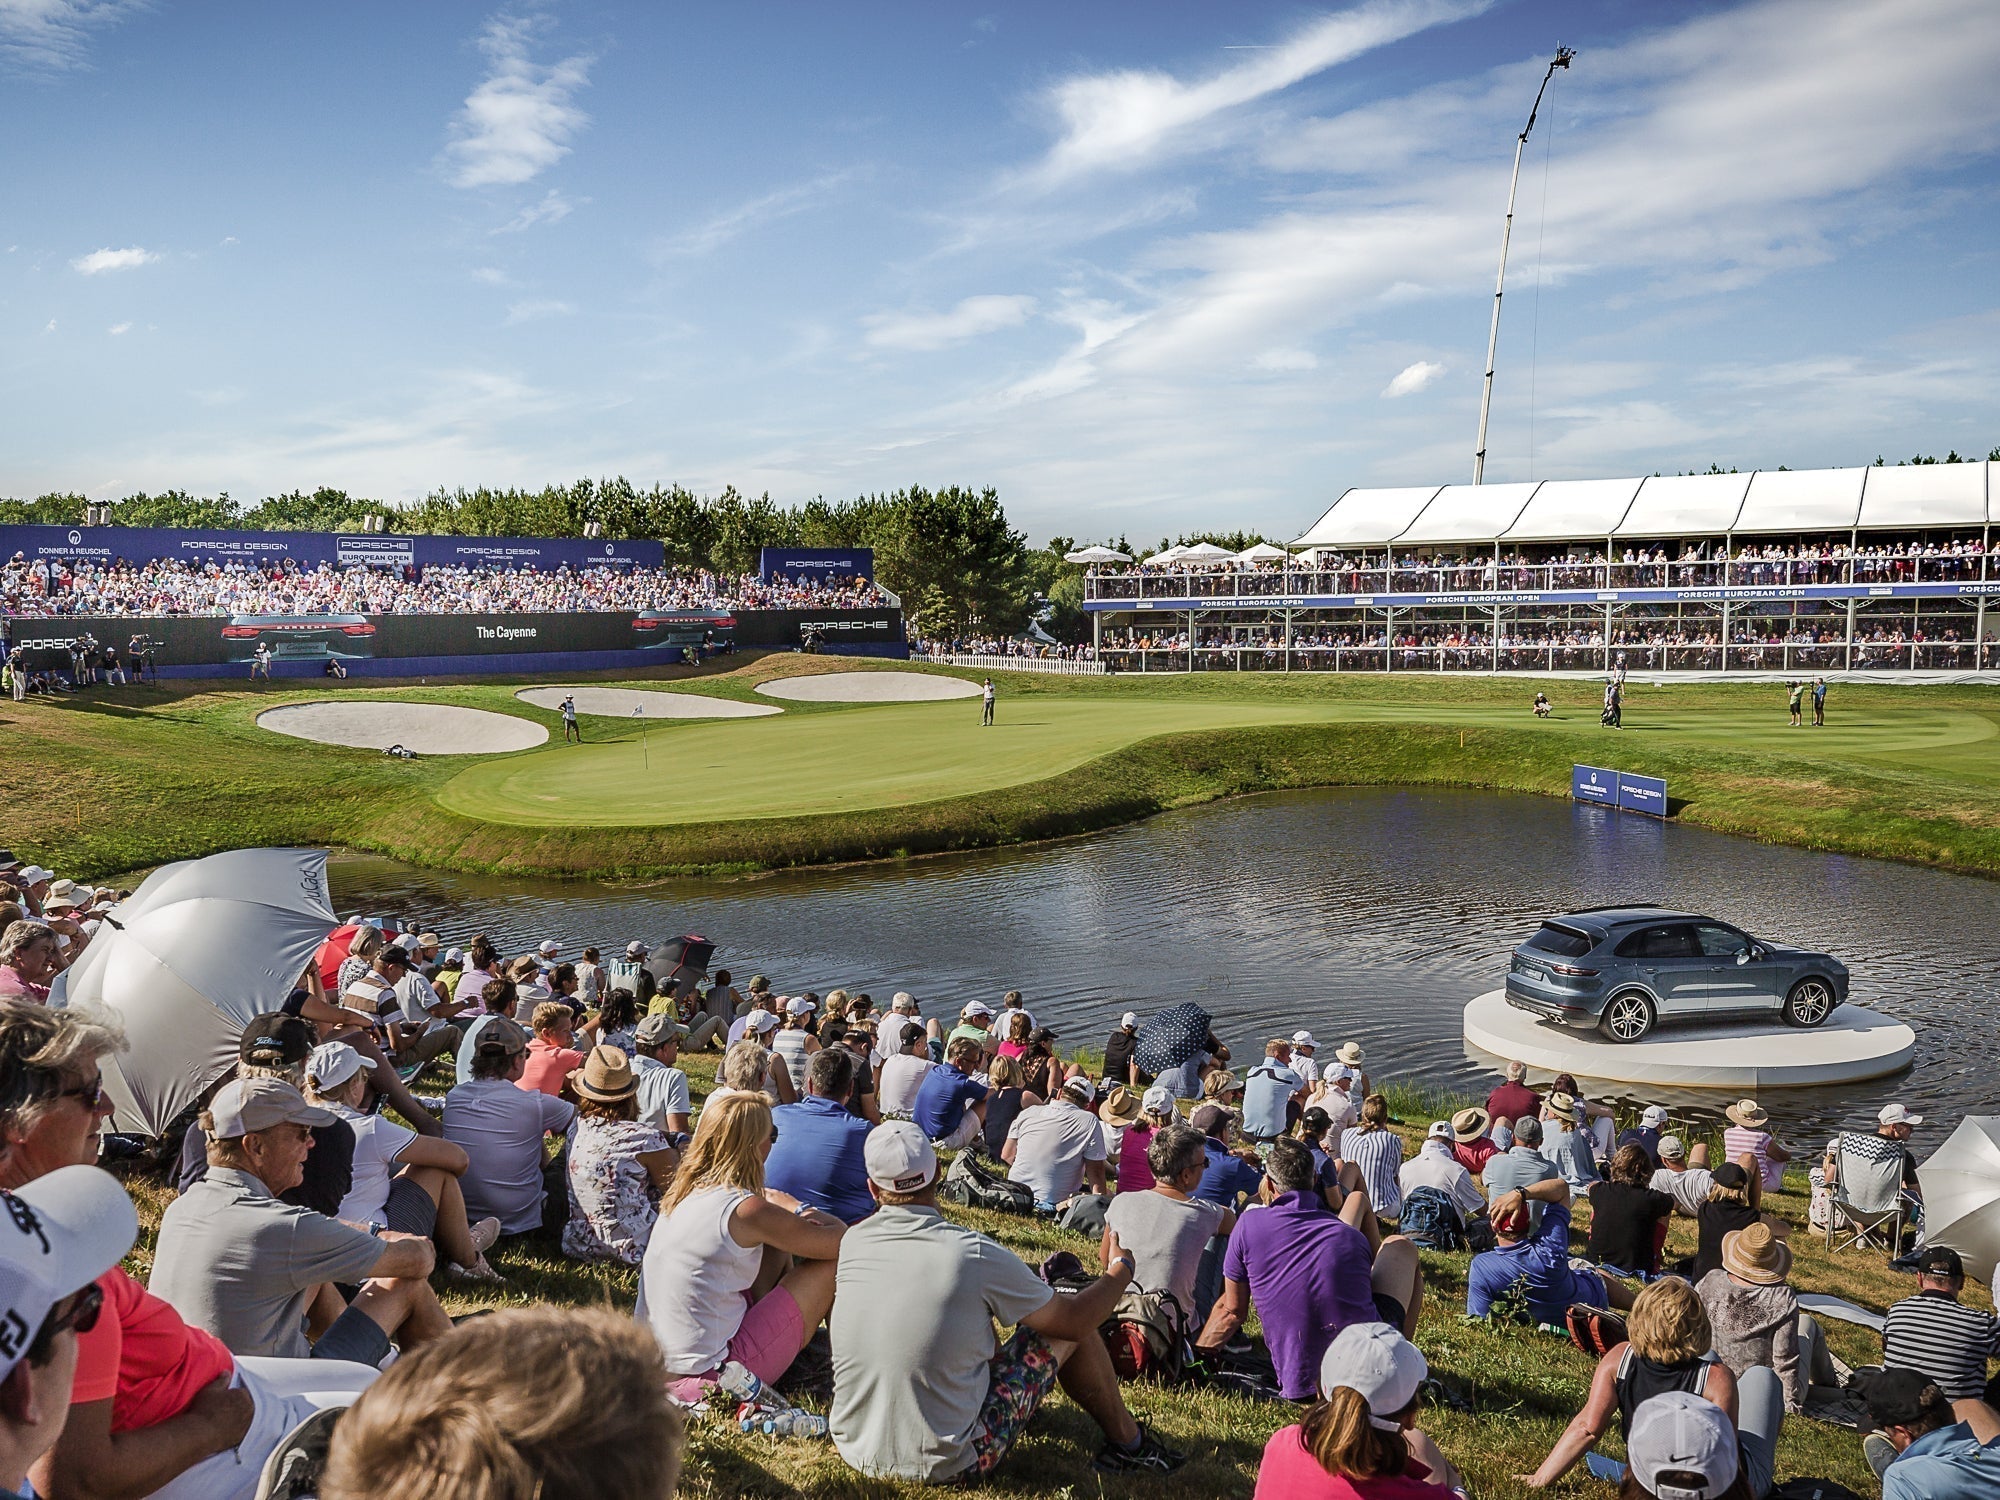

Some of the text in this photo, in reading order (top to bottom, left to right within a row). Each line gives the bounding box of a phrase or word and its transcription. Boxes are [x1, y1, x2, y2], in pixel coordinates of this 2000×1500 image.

[181, 541, 241, 549] PORSCHE
[341, 541, 409, 550] PORSCHE
[38, 547, 68, 555] DONNER
[69, 547, 75, 555] &
[456, 547, 503, 555] PORSCHE
[786, 560, 852, 568] PORSCHE
[800, 620, 889, 630] PORSCHE
[476, 625, 537, 640] The Cayenne
[20, 639, 77, 650] PORSC
